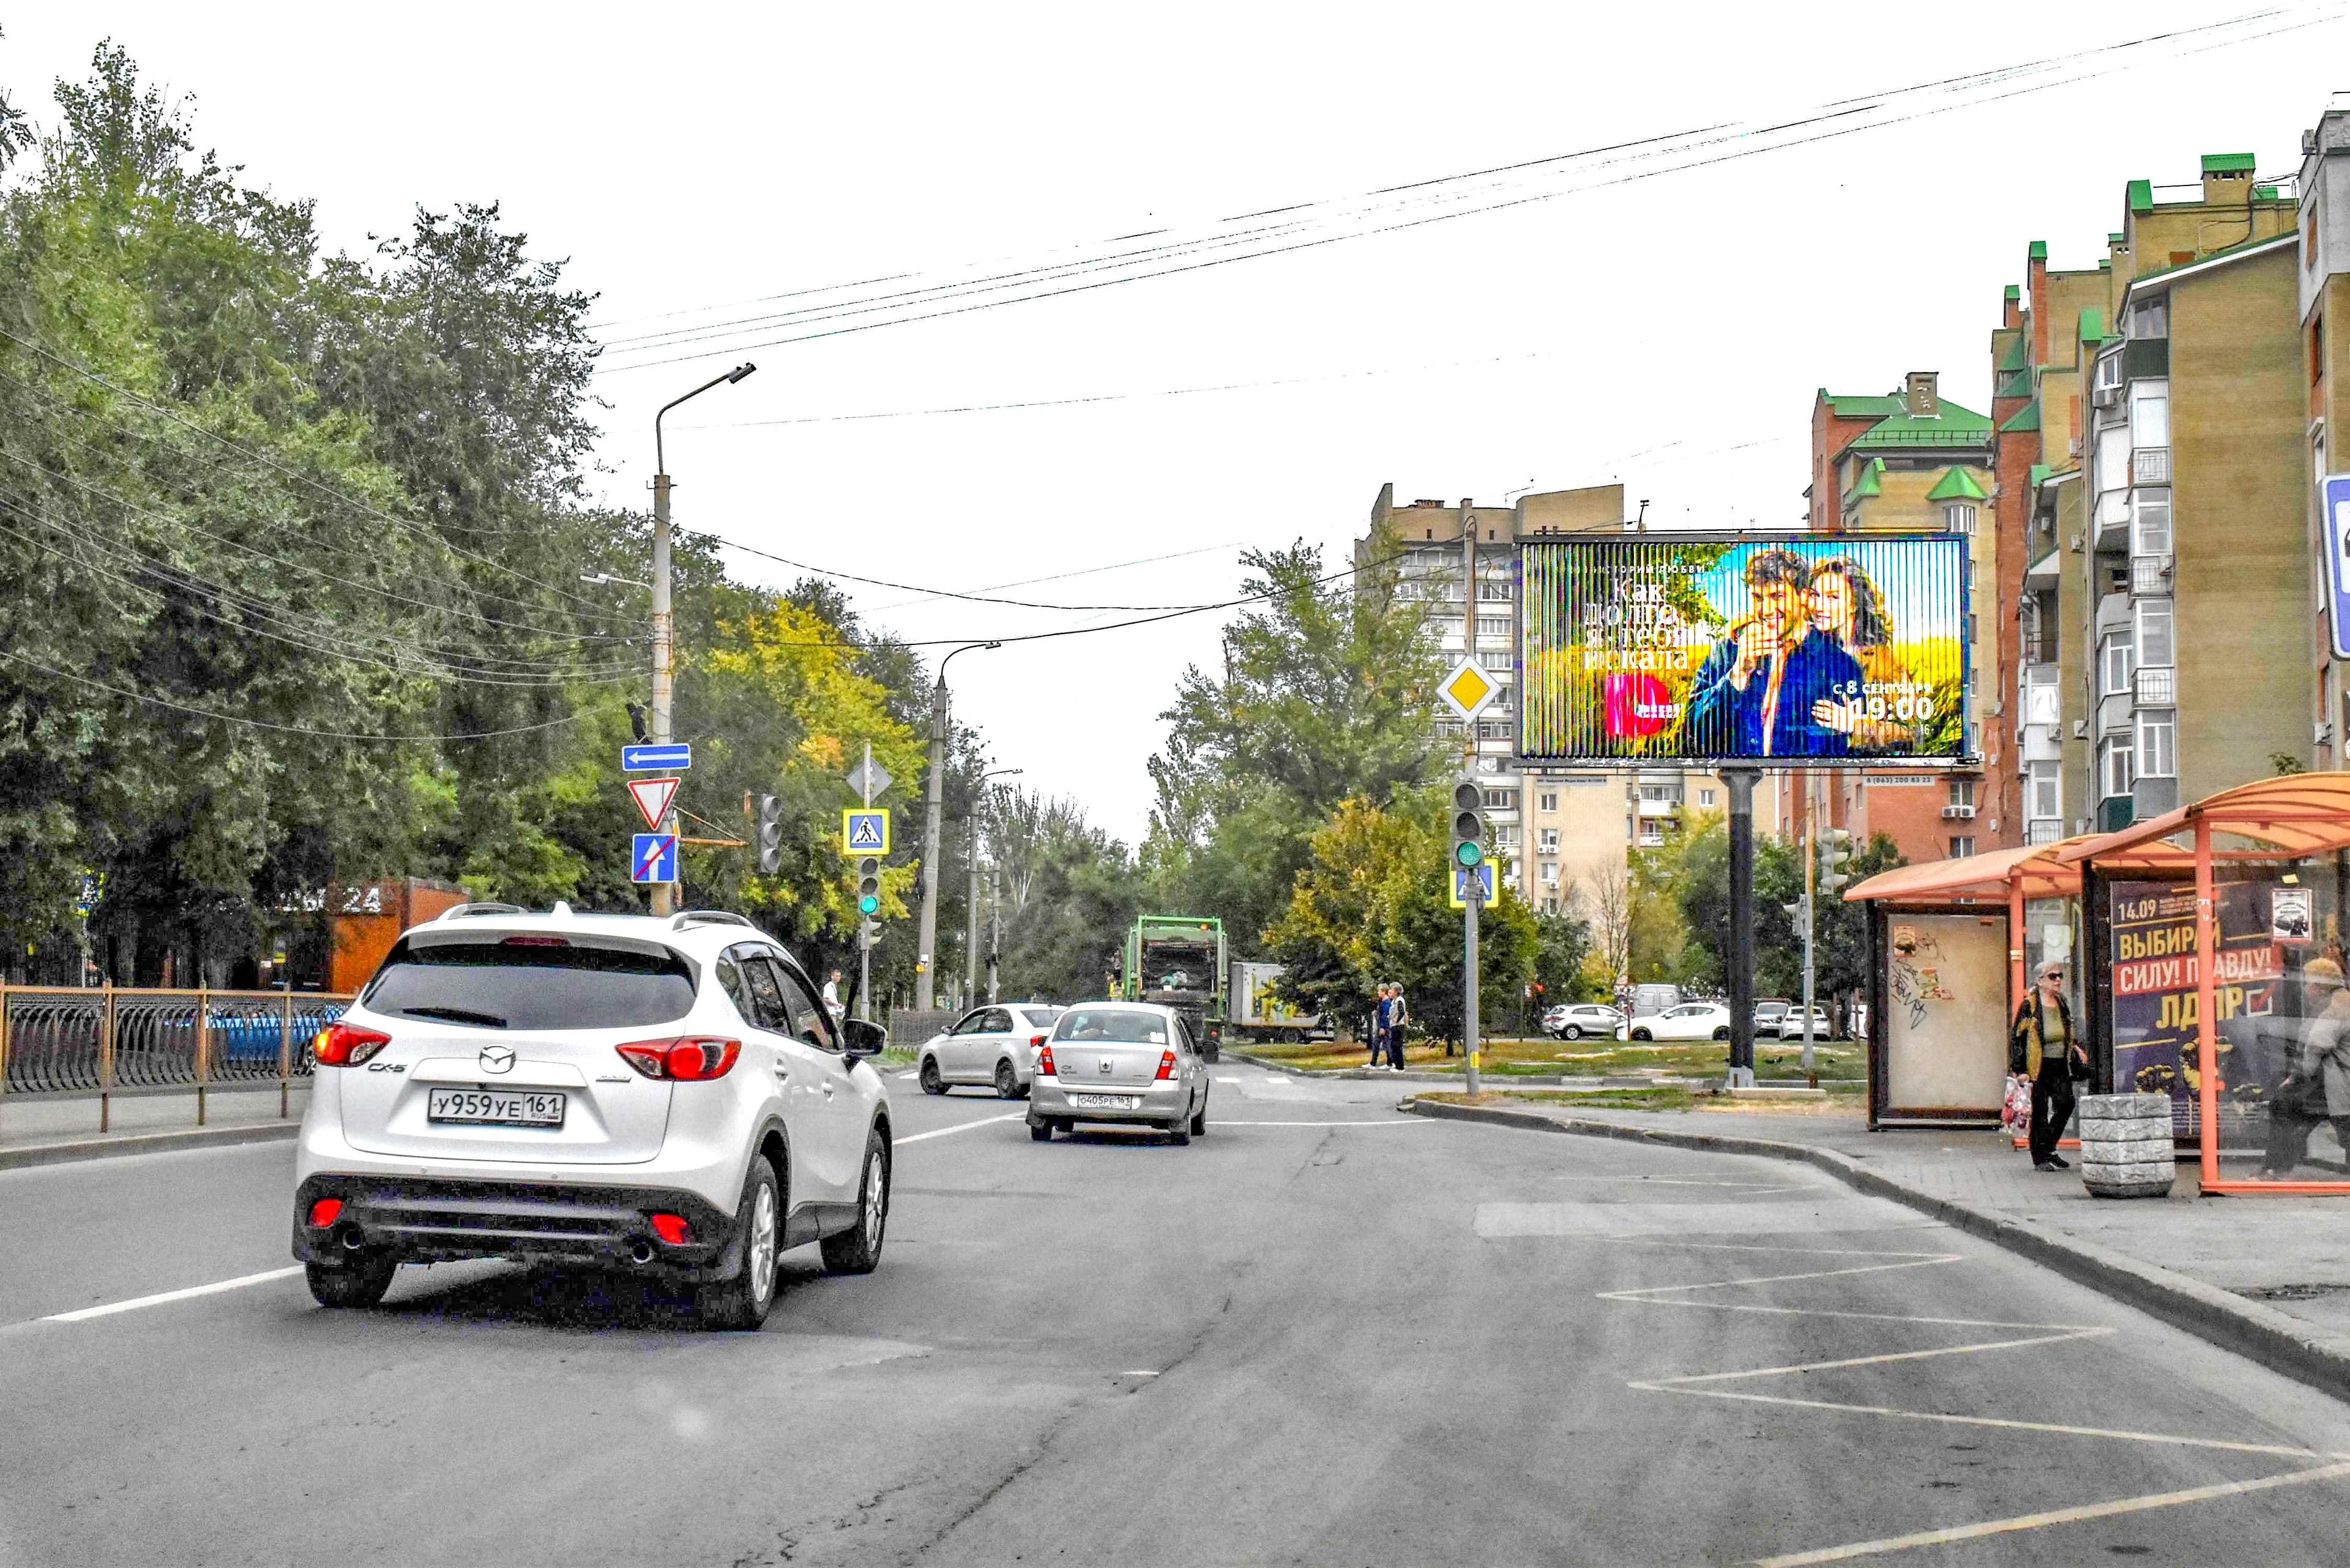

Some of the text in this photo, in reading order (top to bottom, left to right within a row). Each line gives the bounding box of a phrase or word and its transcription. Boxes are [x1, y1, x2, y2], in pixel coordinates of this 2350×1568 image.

[1613, 578, 1666, 602] Как
[1846, 680, 1857, 694] 8
[1853, 696, 1934, 721] 19:00
[2118, 899, 2157, 921] 14.09
[2119, 917, 2222, 960] ВЫБИРЙ
[2120, 947, 2272, 992] СИЛУ! ПАВДУ!
[368, 1062, 407, 1072] CX-5
[526, 1096, 558, 1113] 161
